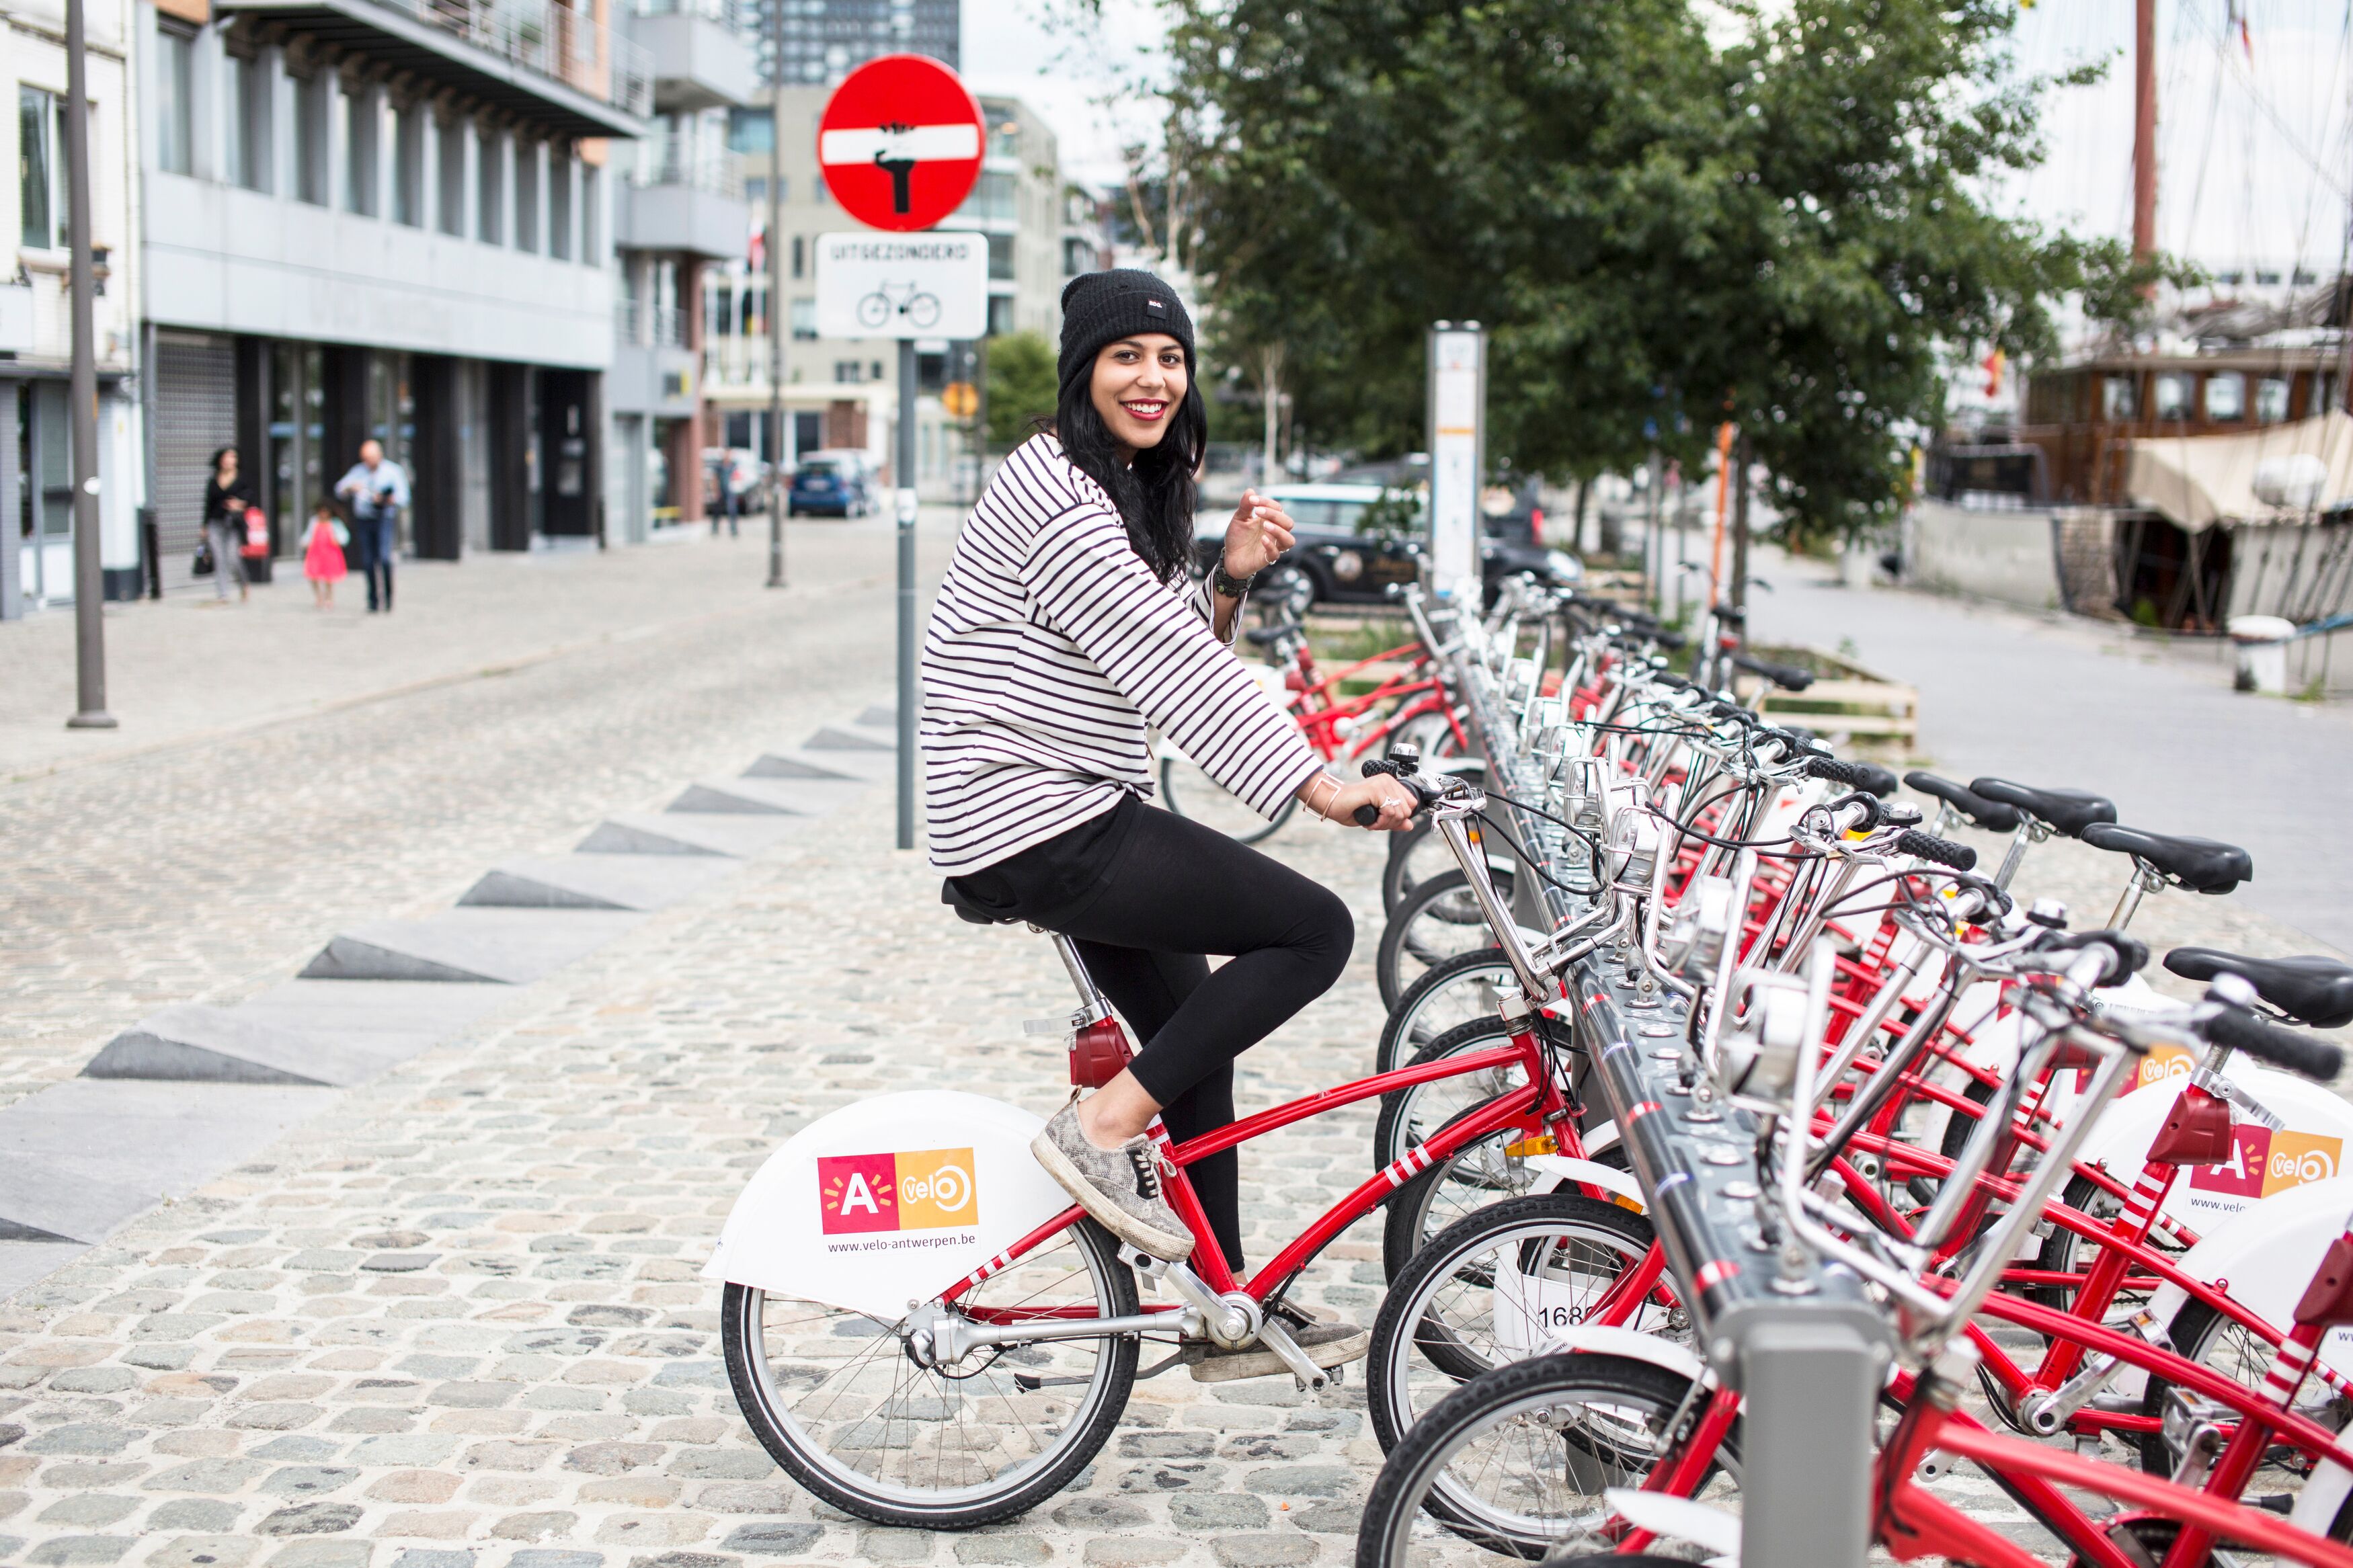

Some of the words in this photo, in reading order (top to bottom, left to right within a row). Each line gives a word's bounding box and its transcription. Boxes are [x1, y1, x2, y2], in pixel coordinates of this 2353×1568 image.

[830, 243, 969, 260] UITGEZONDERD
[2271, 1150, 2334, 1185] velo
[840, 1173, 879, 1215] A
[902, 1165, 971, 1212] velo
[828, 1233, 975, 1253] www.velo-antwerpen.be
